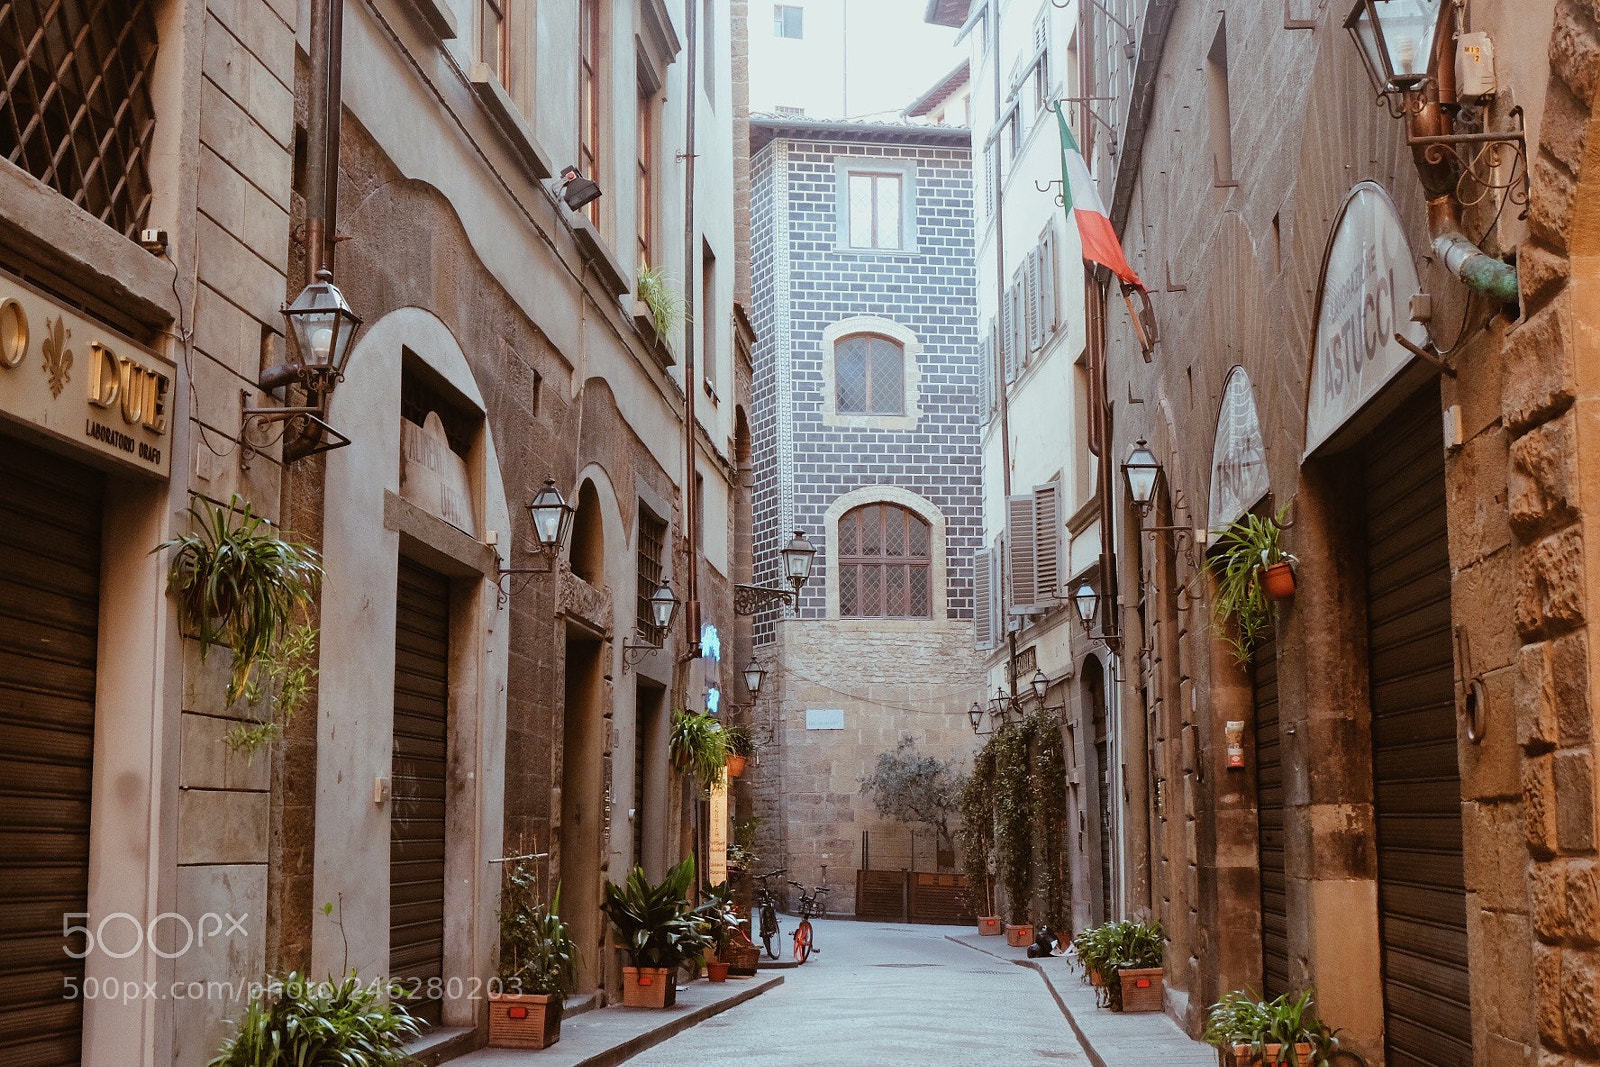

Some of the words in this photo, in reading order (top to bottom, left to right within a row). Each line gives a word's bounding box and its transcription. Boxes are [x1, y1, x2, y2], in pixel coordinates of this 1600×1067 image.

[1325, 267, 1396, 406] ASTUCCI
[88, 340, 170, 436] DUE
[85, 418, 135, 454] LABORATORIO
[138, 441, 161, 466] ORAFO
